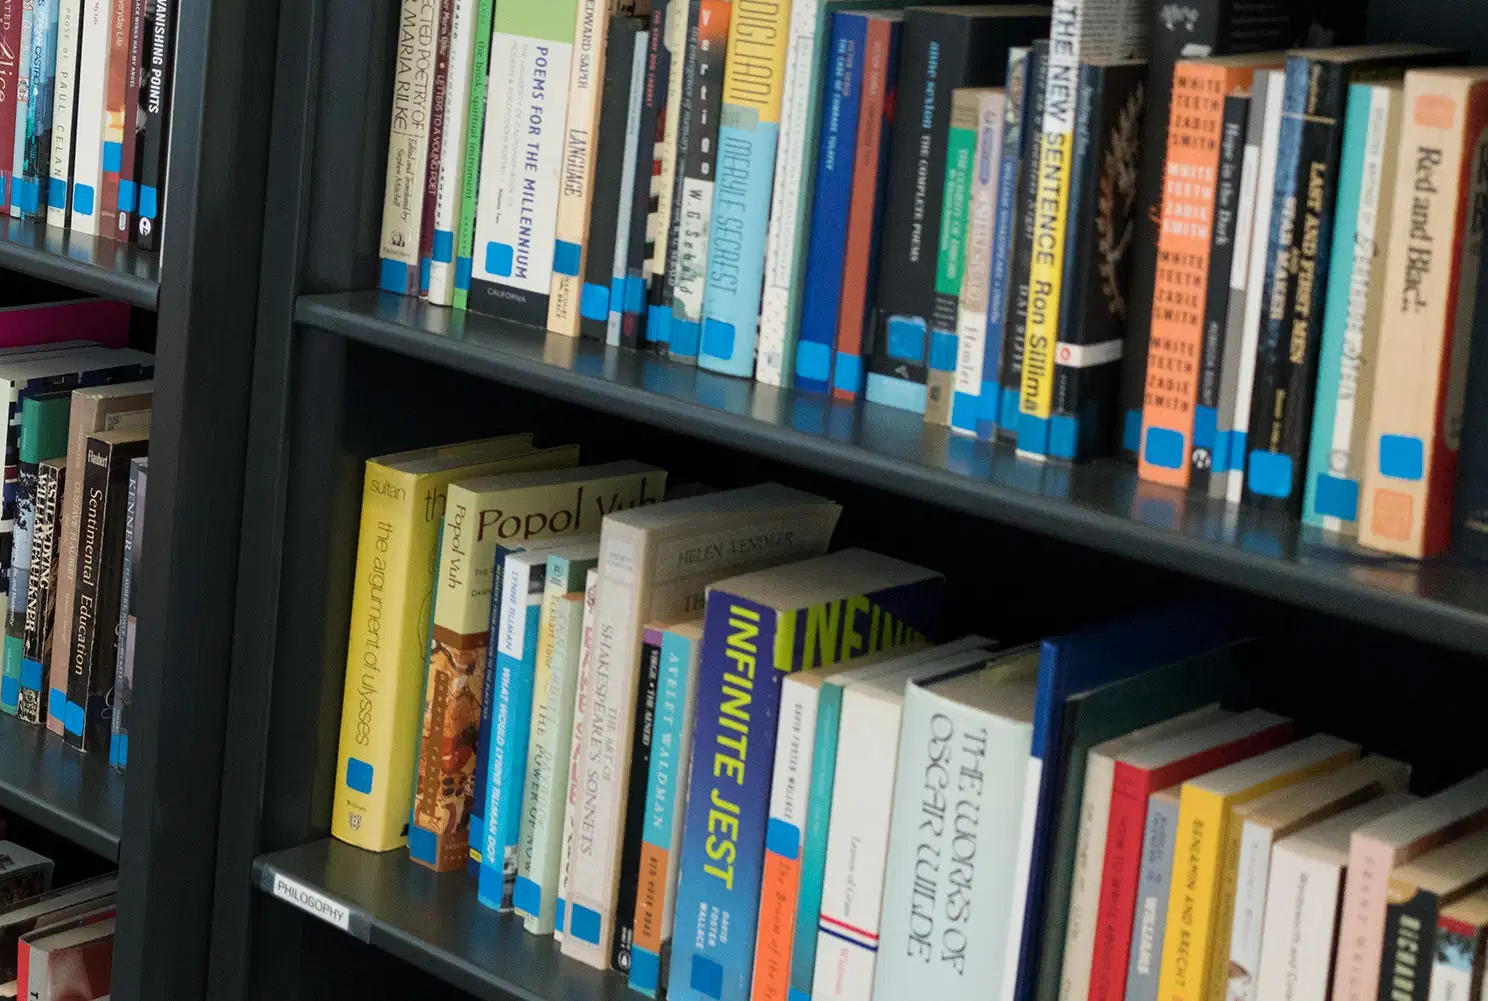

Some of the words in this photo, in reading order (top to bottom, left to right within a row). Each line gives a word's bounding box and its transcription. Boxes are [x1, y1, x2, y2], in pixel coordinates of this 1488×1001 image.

[398, 9, 418, 74] MARIA
[530, 46, 548, 100] POEMS
[578, 53, 592, 88] SAPIR
[148, 68, 162, 114] POINTS
[393, 80, 411, 130] RILKE
[412, 50, 429, 108] POETRY
[410, 109, 424, 130] OF
[528, 106, 544, 135] FOR
[524, 142, 539, 172] THE
[564, 128, 588, 198] LANGUAGE
[718, 136, 752, 213] MERYLE
[515, 178, 536, 280] MILLENNIUM
[710, 216, 742, 296] SECREST
[487, 287, 527, 304] CALIFORNIA
[30, 472, 48, 540] WILLIAM
[124, 478, 136, 550] KENNER
[371, 478, 406, 501] sultan
[82, 488, 102, 586] Sentimental
[375, 520, 394, 552] the
[448, 504, 468, 554] Popol
[25, 539, 42, 632] FAULKNER
[364, 557, 388, 652] argument
[448, 557, 462, 589] Vuh
[74, 594, 93, 676] Education
[363, 652, 380, 672] of
[355, 674, 378, 746] ulysses
[589, 624, 614, 762] SHAKESPEARE'S
[662, 652, 681, 724] AYELET
[713, 604, 760, 784] INFINITE
[652, 731, 674, 830] WALDMAN
[918, 712, 955, 837] OSCAR
[958, 728, 988, 796] THE
[580, 768, 600, 856] SONNETS
[702, 788, 741, 890] JEST
[944, 799, 981, 923] WORKS
[277, 879, 344, 921] PHILOSOPHY
[695, 901, 710, 950] WALLACE
[708, 904, 721, 948] FOSTER
[906, 843, 942, 964] WILDE
[940, 928, 968, 976] OF
